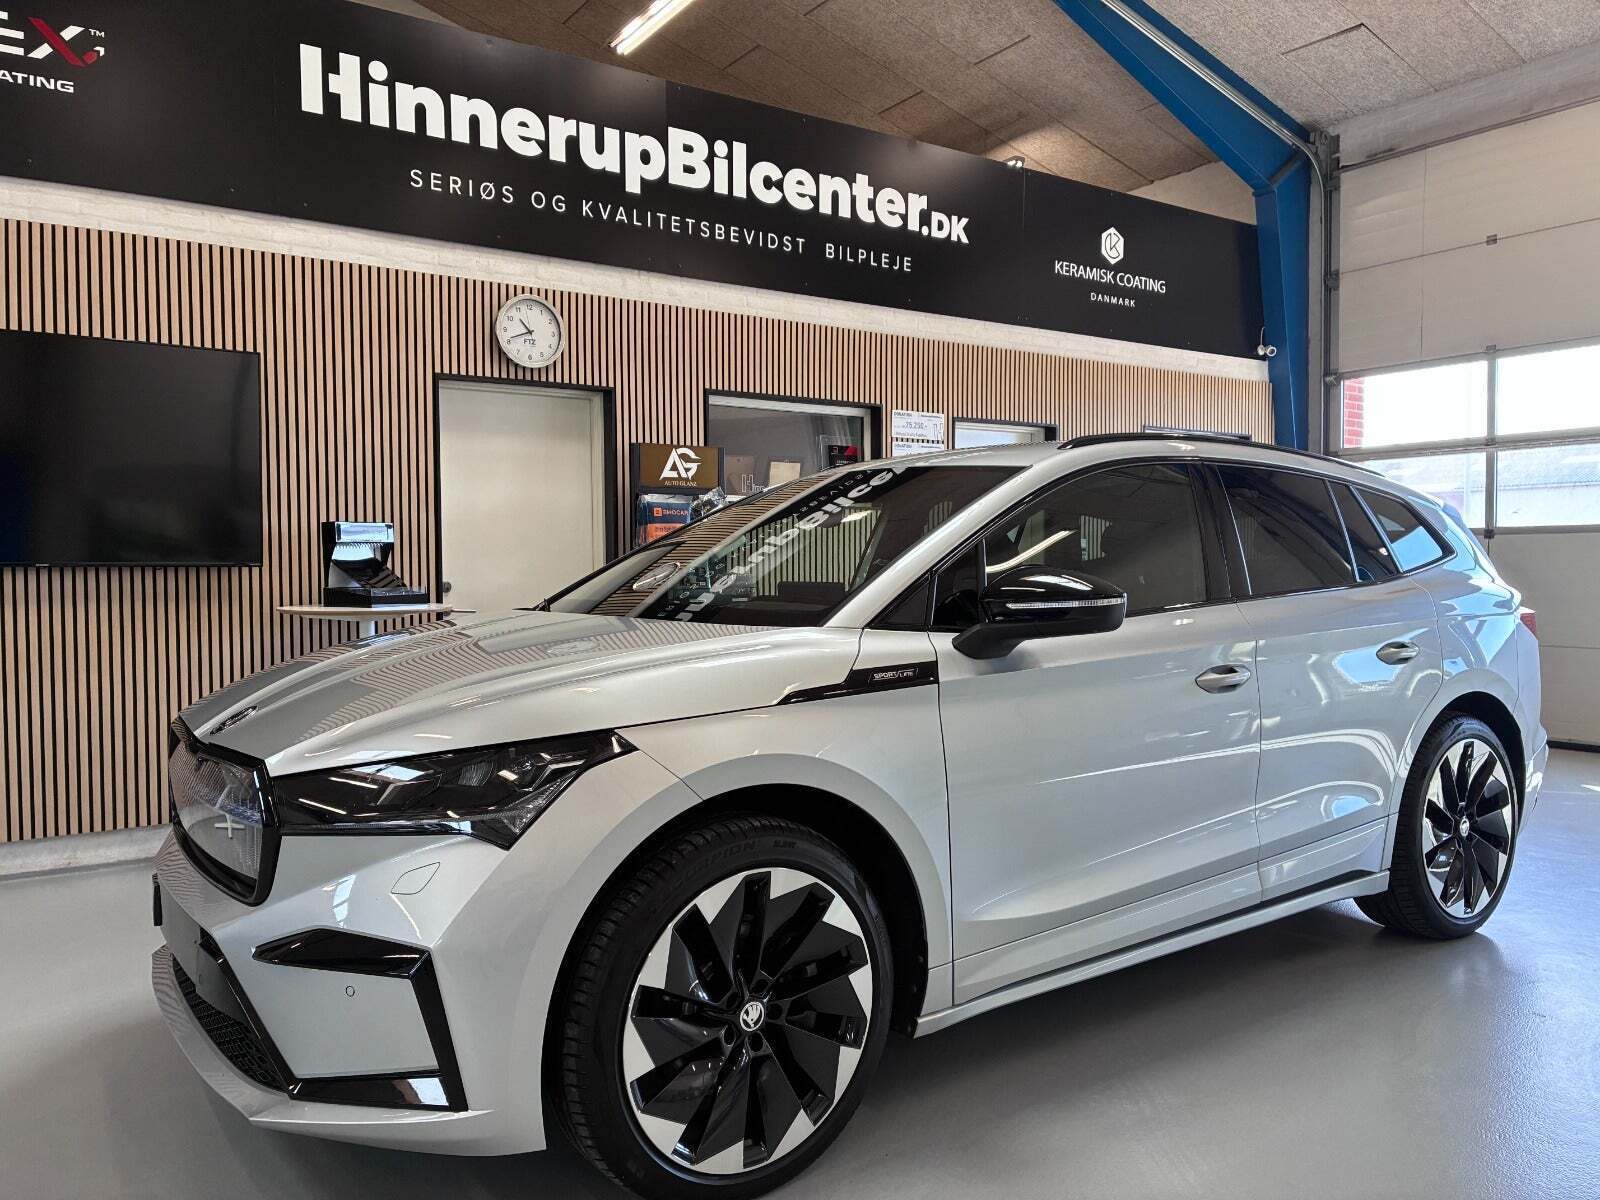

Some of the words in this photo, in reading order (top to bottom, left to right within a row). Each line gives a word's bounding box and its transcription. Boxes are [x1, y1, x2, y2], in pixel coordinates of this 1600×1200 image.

[410, 169, 514, 204] SERIØS
[531, 191, 566, 213] OG
[582, 199, 805, 254] KVALITETSBEVIDST
[825, 243, 912, 272] BILPLEJE
[1055, 259, 1115, 285] KERAMISK
[1116, 272, 1166, 294] COATING
[1090, 292, 1136, 308] DANMARK
